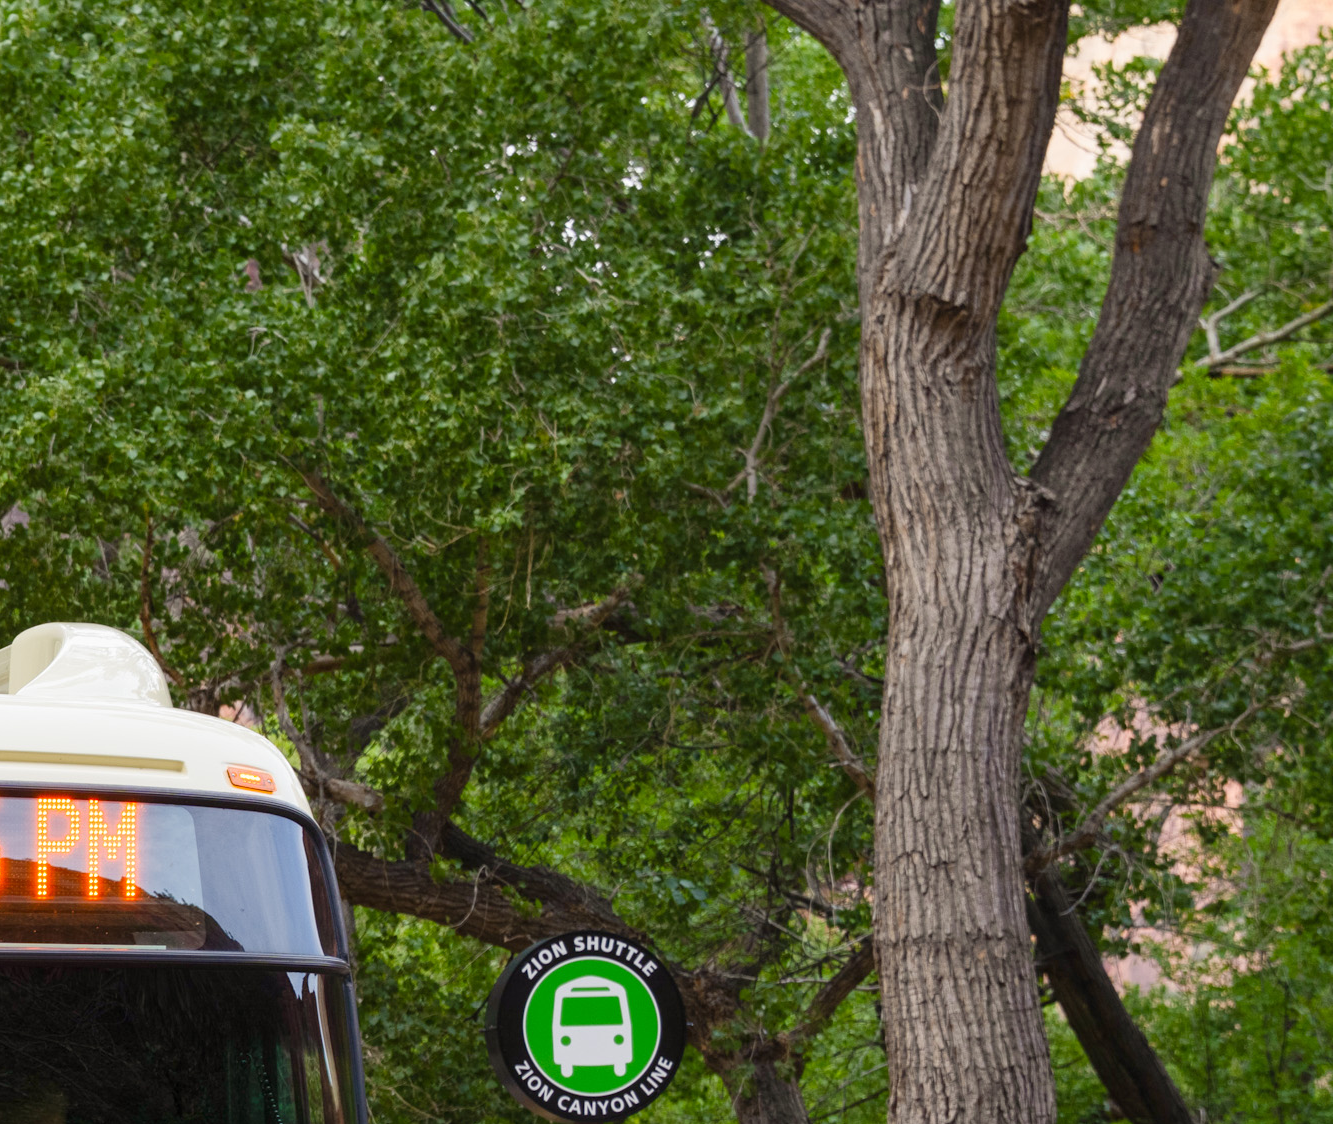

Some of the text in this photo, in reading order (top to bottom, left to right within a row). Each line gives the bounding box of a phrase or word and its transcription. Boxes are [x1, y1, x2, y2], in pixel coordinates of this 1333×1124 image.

[34, 798, 140, 900] PM
[521, 935, 658, 980] ZION SHUTTLE
[514, 1056, 673, 1116] ZION CANYON LINE
